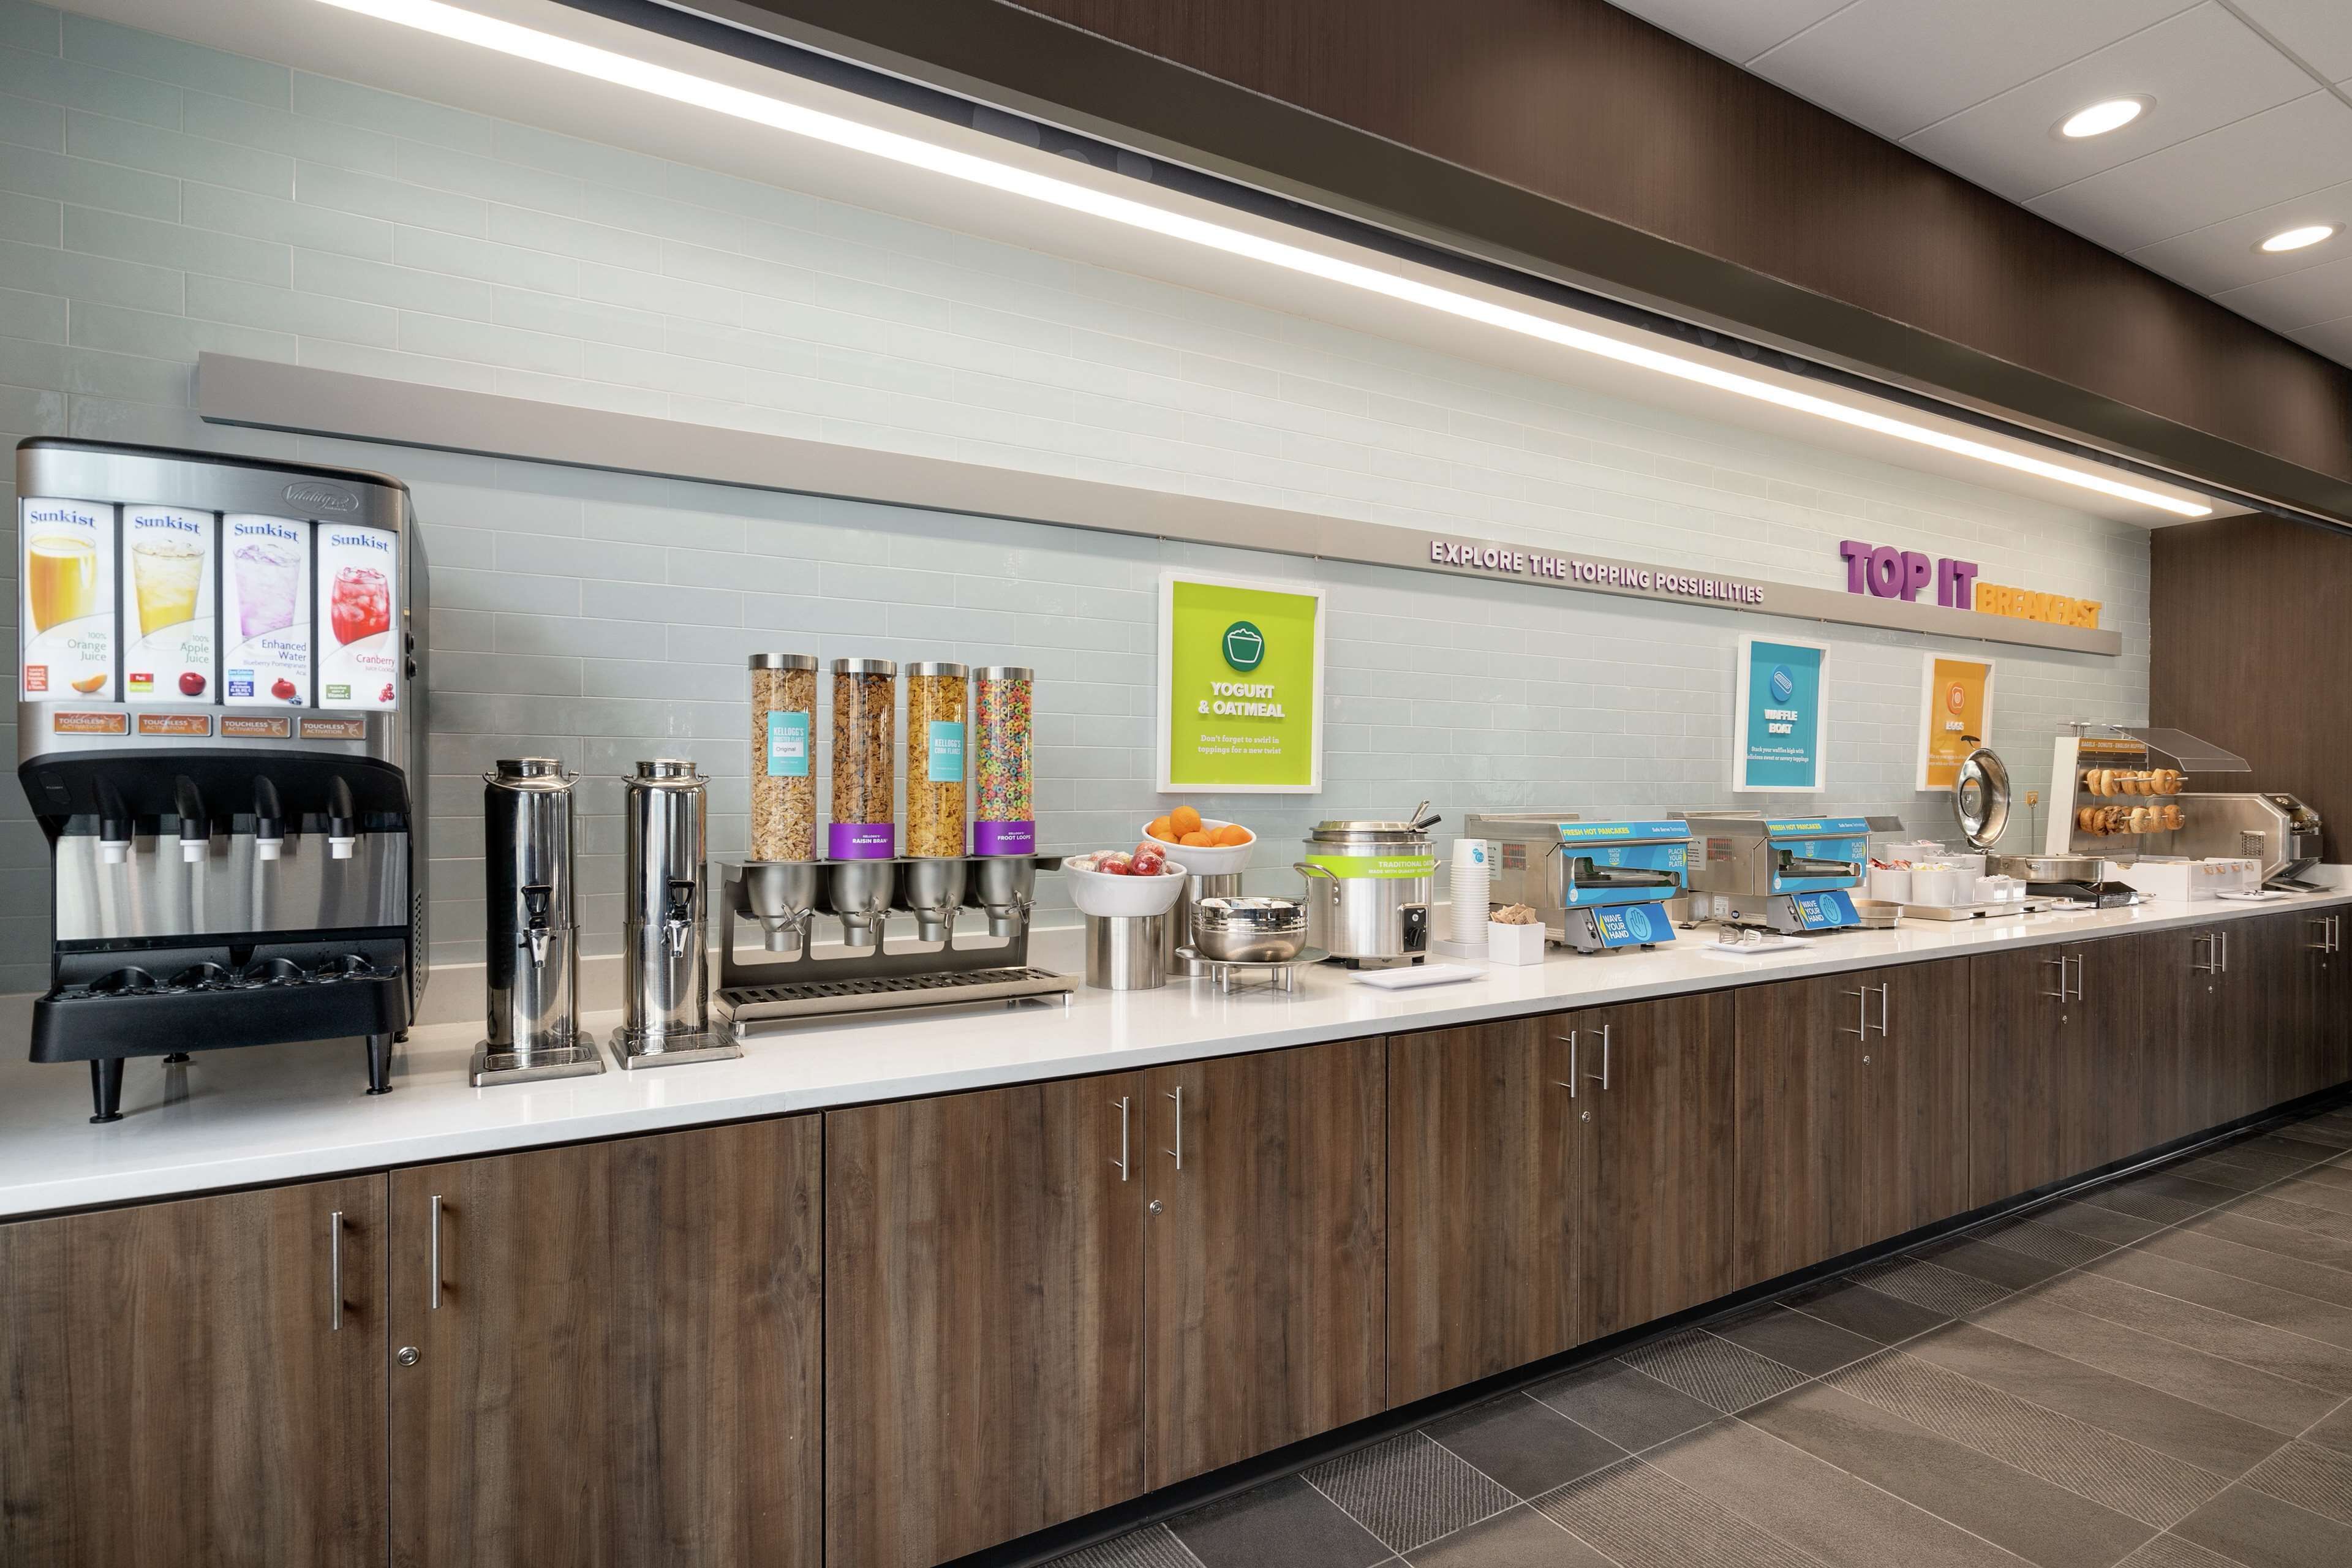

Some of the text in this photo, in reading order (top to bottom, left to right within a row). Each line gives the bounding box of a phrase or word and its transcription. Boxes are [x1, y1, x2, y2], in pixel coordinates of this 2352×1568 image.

[30, 510, 96, 528] Sunkist
[134, 516, 200, 534] Sunkist
[235, 524, 299, 542] Sunkist
[331, 534, 389, 552] Sunkist
[1431, 540, 1765, 603] EXPLORE THE TOPPING POSSIBILITIES
[1840, 540, 1978, 610] TOP IT
[1976, 582, 2102, 628] BREAKFAST
[67, 639, 107, 653] Orange
[180, 643, 209, 654] Apple
[262, 639, 306, 651] Enhanced
[80, 651, 107, 662] Juice
[186, 653, 209, 663] Juice
[279, 650, 306, 662] Water
[356, 654, 395, 666] Cranberry
[1210, 681, 1275, 698] YOGURT
[1197, 700, 1285, 718] & OATMEAL
[1765, 709, 1798, 721] WAFFLE
[773, 726, 804, 736] KELLOGG'S
[1769, 723, 1793, 734] BOAT
[1946, 722, 1964, 730] EGGS
[935, 739, 960, 747] KELLOGG'S
[1222, 735, 1243, 744] forget
[1197, 745, 1230, 755] toppings
[1606, 922, 1626, 931] YOUR
[1610, 930, 1629, 939] HAND
